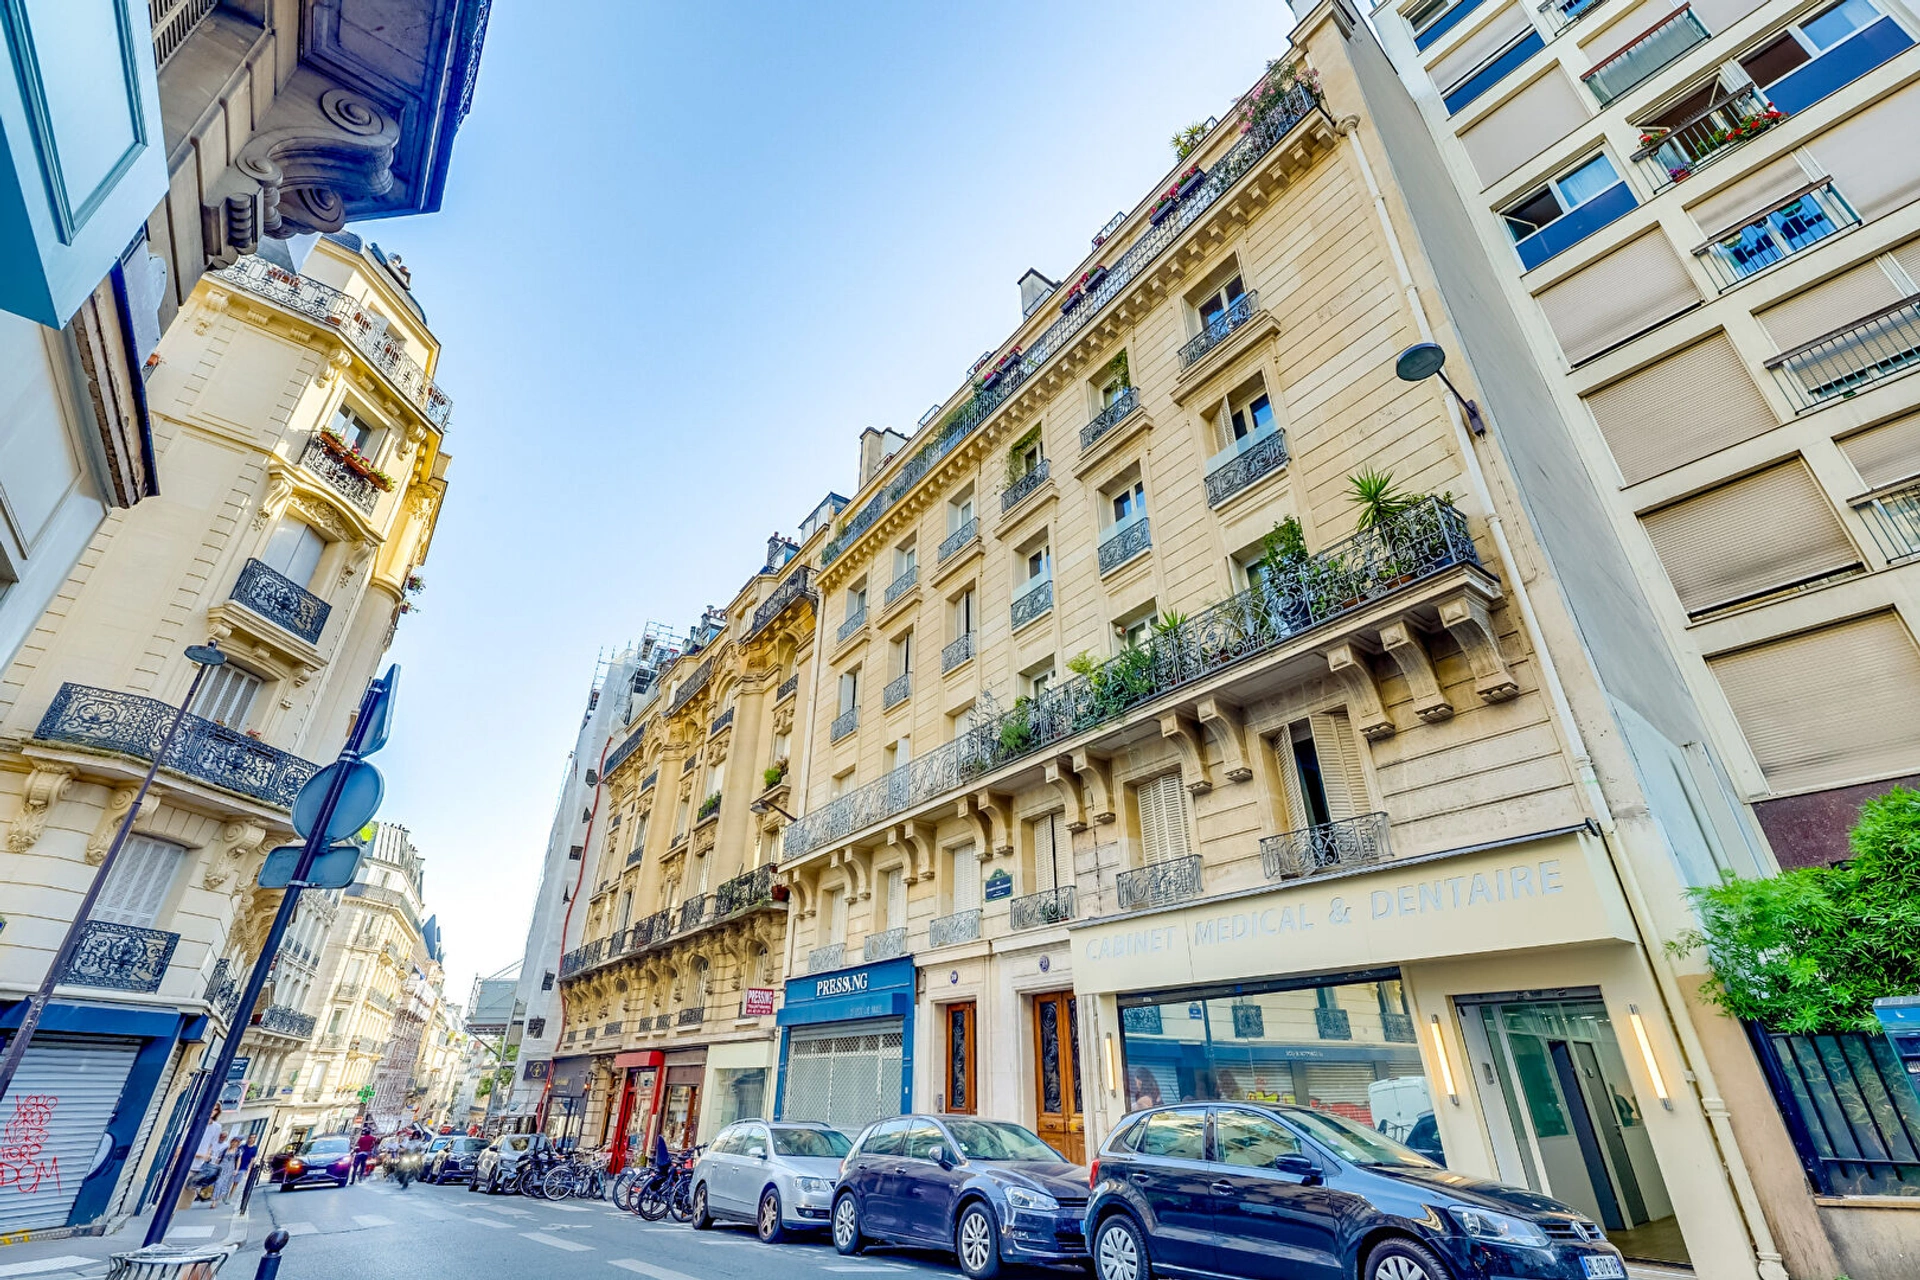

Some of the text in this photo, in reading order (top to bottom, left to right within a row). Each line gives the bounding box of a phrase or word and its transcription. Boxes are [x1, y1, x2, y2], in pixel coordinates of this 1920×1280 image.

[1085, 859, 1563, 961] CABINET MEDICAL & DENTAIRE
